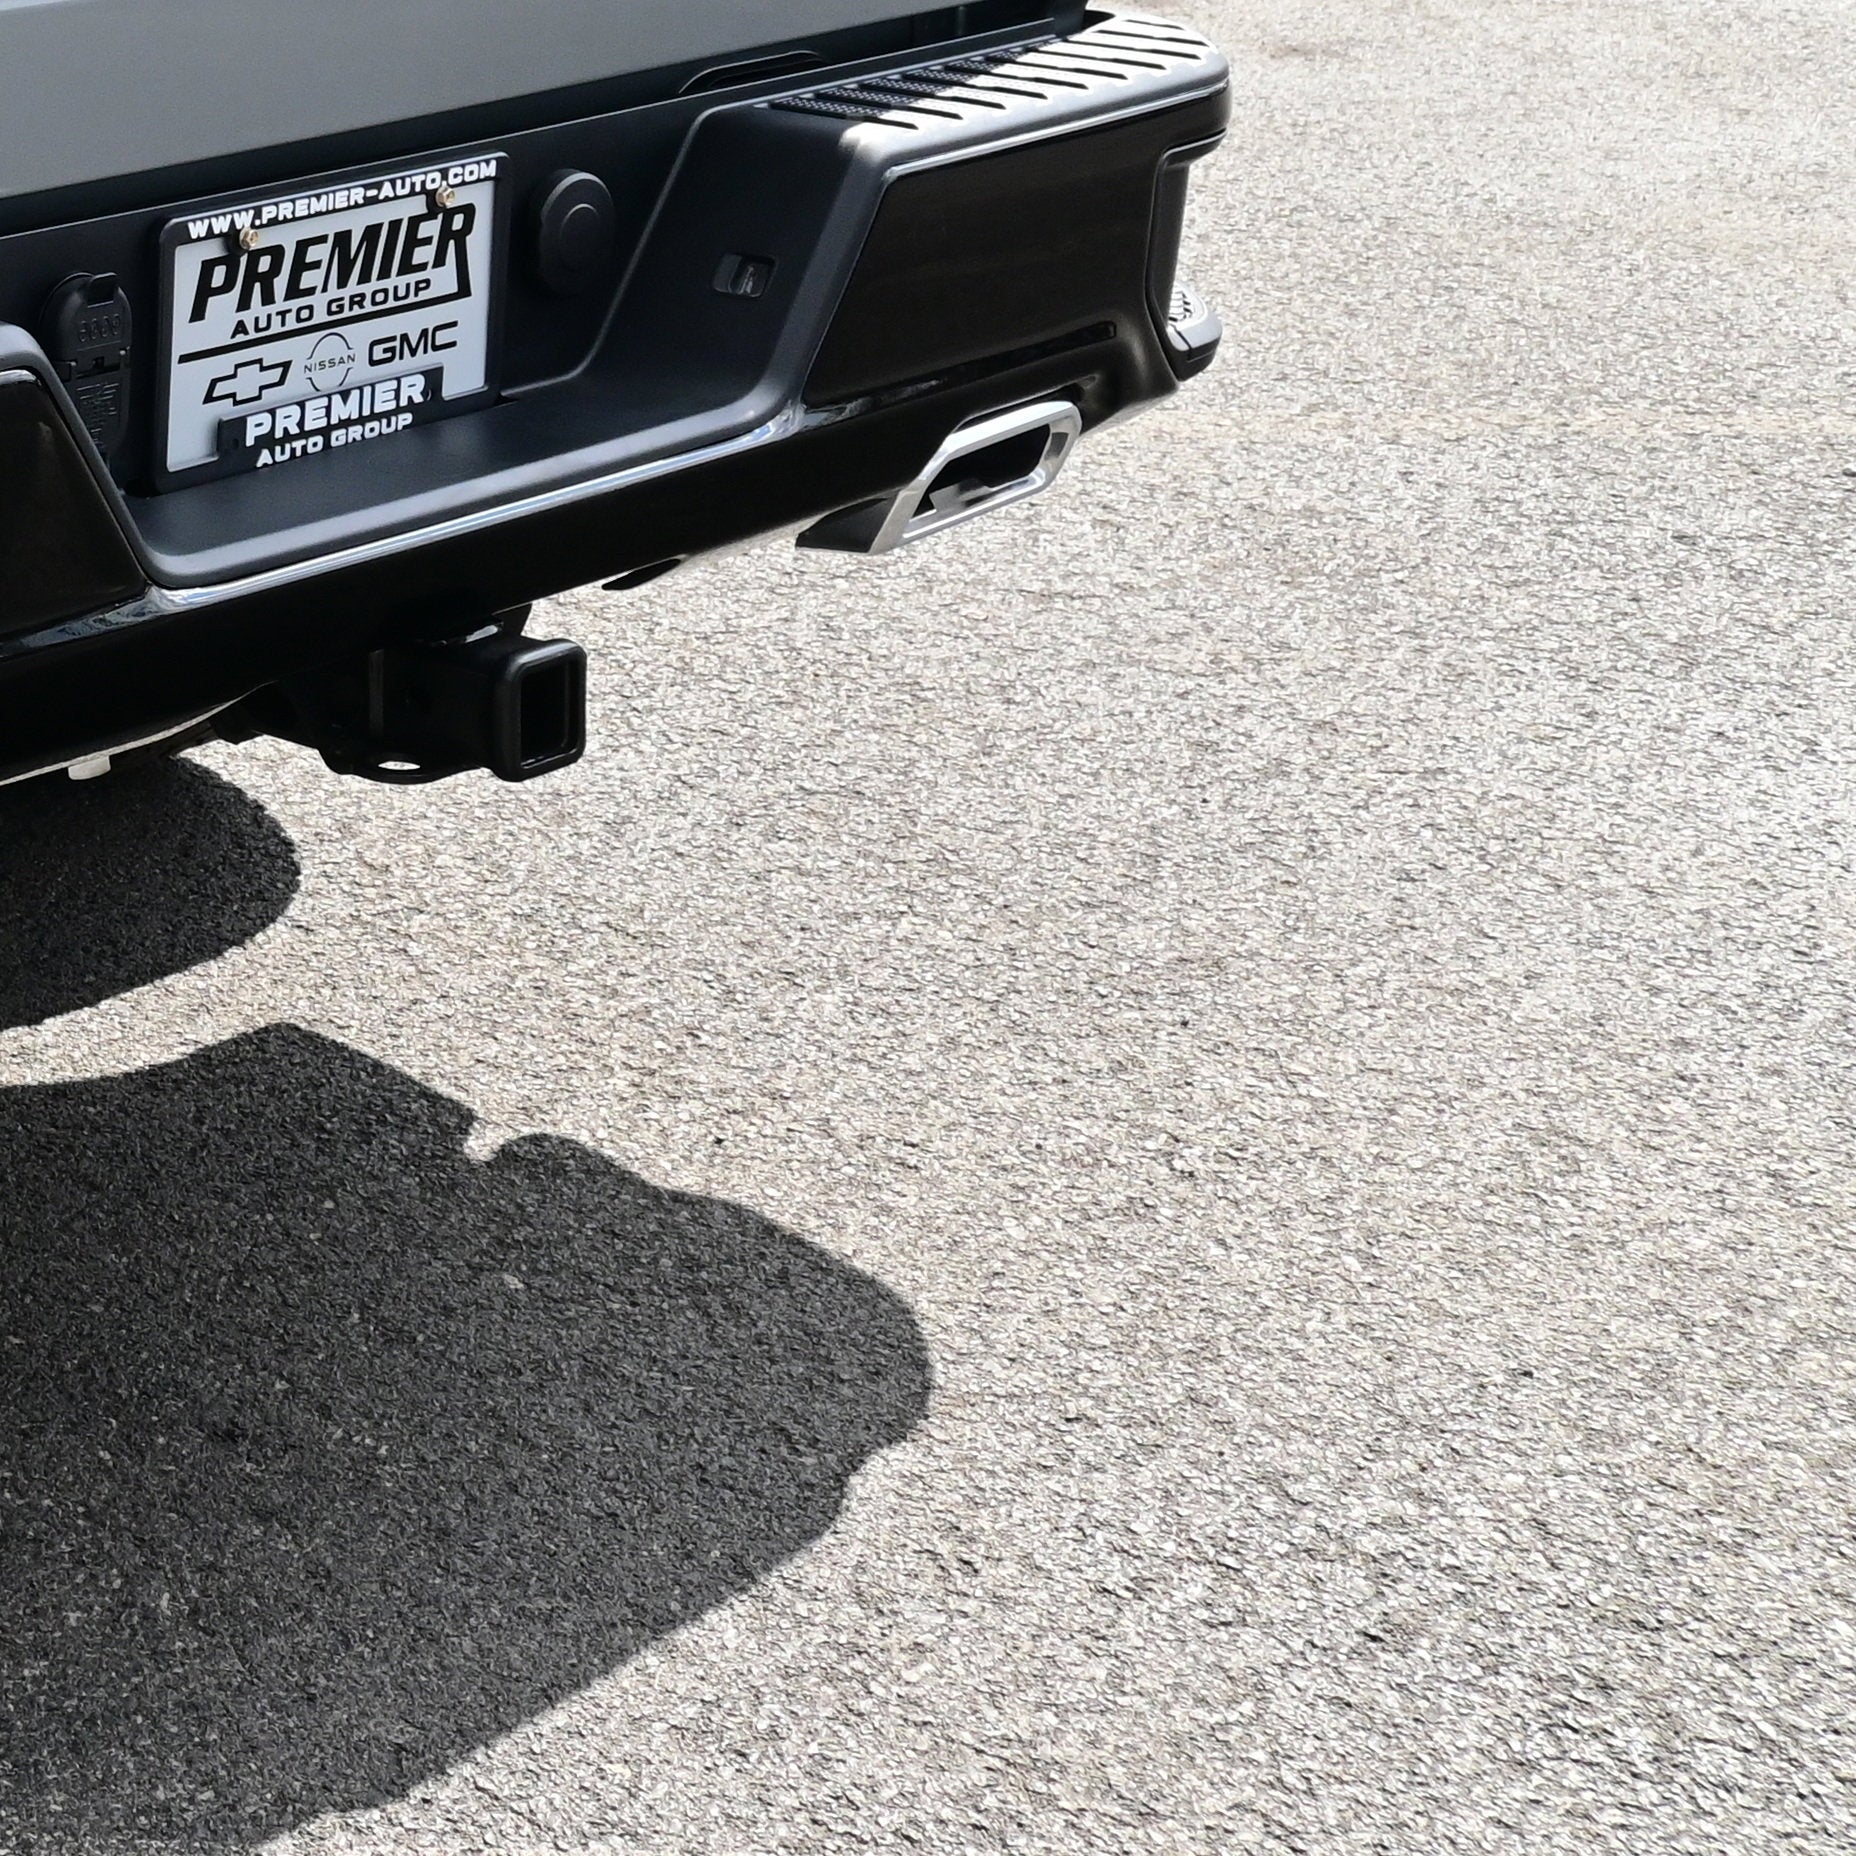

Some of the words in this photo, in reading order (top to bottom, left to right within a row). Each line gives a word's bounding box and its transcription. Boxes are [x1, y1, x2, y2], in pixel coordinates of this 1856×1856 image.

[187, 159, 497, 240] WWW.PREMIER-AUTO.COM
[187, 201, 477, 324] PREMIER
[229, 302, 315, 340] AUTO
[325, 278, 432, 318] GROUP
[303, 351, 357, 375] NISSAN
[367, 320, 459, 368] GMC
[244, 373, 427, 448] PREMIER
[255, 435, 324, 469] AUTO
[329, 412, 414, 448] GROUP
